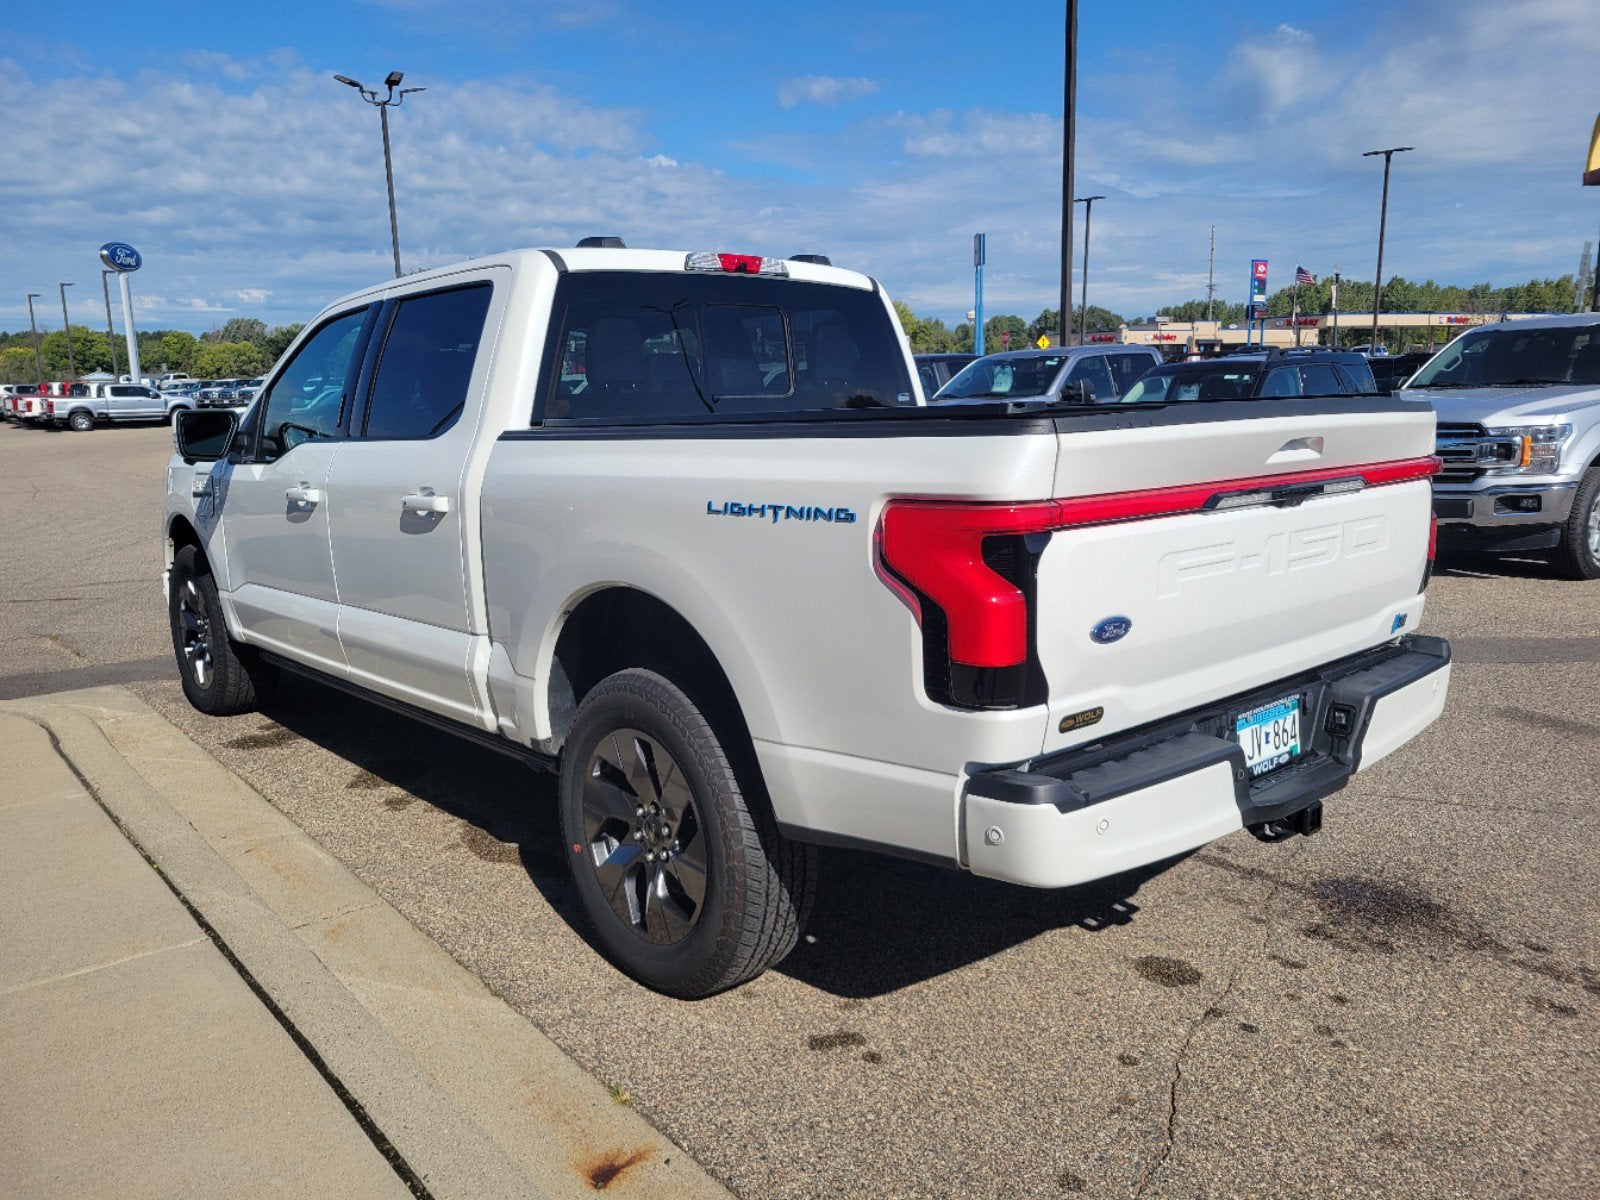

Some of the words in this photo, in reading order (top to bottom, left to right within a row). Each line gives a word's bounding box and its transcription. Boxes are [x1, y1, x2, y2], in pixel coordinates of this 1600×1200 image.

[115, 248, 137, 266] Ford
[706, 500, 857, 524] LIGHTNING
[1157, 513, 1391, 600] F-150
[1102, 622, 1126, 640] Ford
[1074, 708, 1103, 724] WOLF
[1238, 726, 1263, 761] JV
[1273, 713, 1298, 751] 864
[1252, 756, 1278, 776] WOLF
